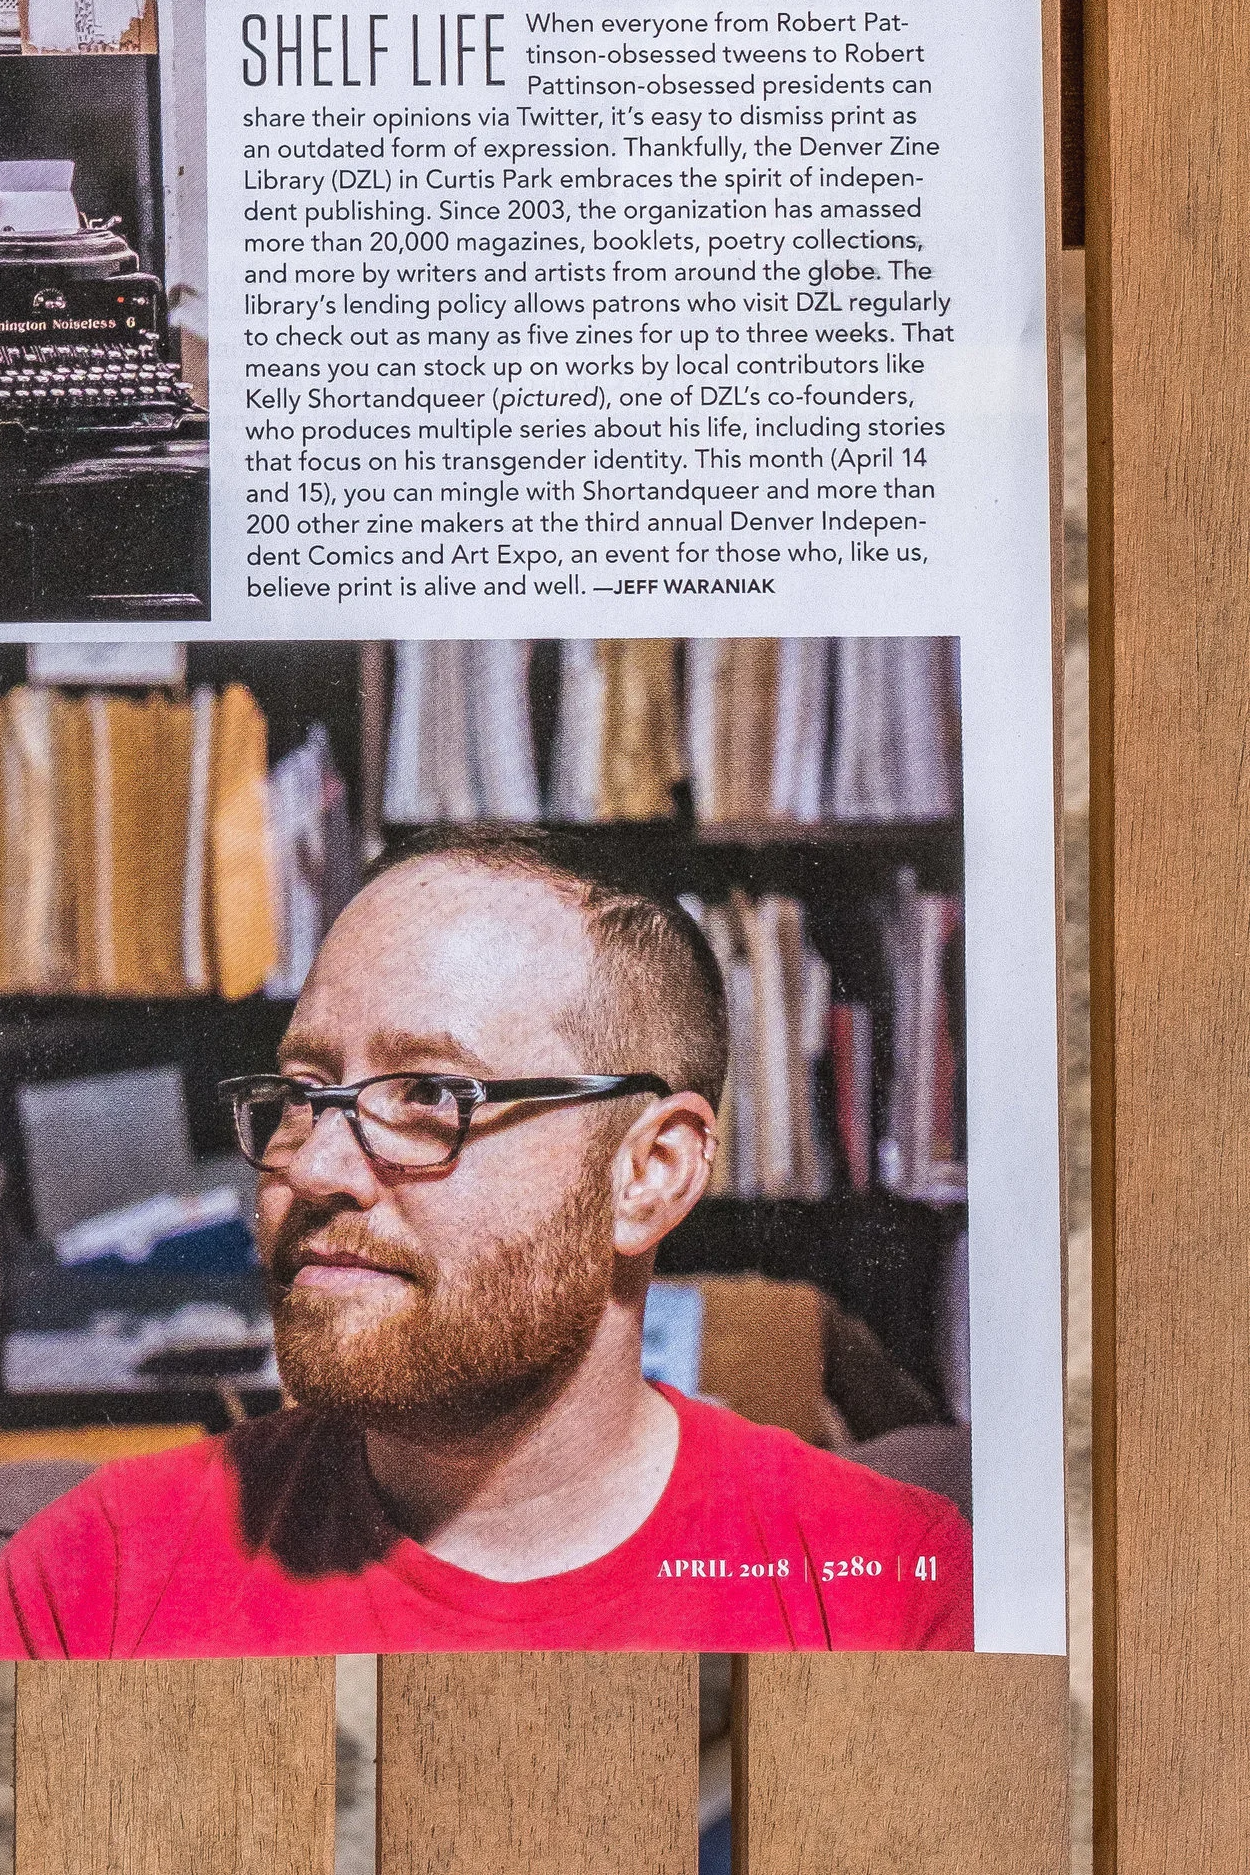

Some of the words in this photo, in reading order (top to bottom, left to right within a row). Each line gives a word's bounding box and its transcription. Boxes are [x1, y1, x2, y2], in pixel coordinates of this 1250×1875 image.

[525, 11, 594, 33] When
[601, 18, 708, 39] everyone
[714, 11, 769, 33] from
[777, 10, 857, 32] Robert
[864, 11, 909, 32] Pat-
[242, 13, 389, 87] SHELF
[412, 13, 506, 87] LIFE
[525, 42, 716, 65] tinson-obsessed
[722, 46, 807, 64] tweens
[812, 46, 837, 63] to
[845, 41, 925, 63] Robert
[528, 73, 755, 95] Pattinson-obsessed
[763, 73, 885, 102] presidents
[892, 79, 932, 94] can
[243, 106, 305, 127] share
[311, 105, 366, 127] their
[373, 106, 471, 135] opinions
[478, 106, 510, 127] via
[516, 106, 603, 129] Twitter,
[611, 105, 644, 126] it’s
[651, 111, 703, 132] easy
[708, 108, 733, 126] to
[740, 104, 824, 126] dismiss
[831, 105, 886, 133] print
[892, 110, 917, 125] as
[243, 144, 270, 159] an
[277, 136, 384, 159] outdated
[391, 136, 446, 158] form
[453, 136, 478, 158] of
[483, 137, 616, 165] expression.
[623, 135, 747, 163] Thankfully,
[753, 135, 792, 157] the
[800, 136, 883, 157] Denver
[889, 135, 940, 156] Zine
[244, 168, 325, 196] Library
[331, 169, 392, 193] (DZL)
[399, 169, 418, 189] in
[426, 168, 495, 189] Curtis
[503, 167, 553, 189] Park
[560, 167, 673, 189] embraces
[679, 166, 718, 188] the
[724, 167, 782, 195] spirit
[789, 165, 813, 188] of
[819, 165, 924, 194] indepen-
[53, 318, 117, 330] Noiseless
[247, 575, 331, 598] believe
[338, 576, 393, 604] print
[400, 576, 417, 596] is
[424, 574, 477, 596] alive
[483, 573, 526, 596] and
[533, 573, 586, 596] well.
[592, 579, 659, 595] —JEFF
[663, 578, 776, 595] WARANIAK
[656, 1559, 733, 1578] APRIL
[739, 1558, 790, 1578] 2018
[821, 1555, 882, 1582] 5280
[914, 1555, 937, 1582] 41
